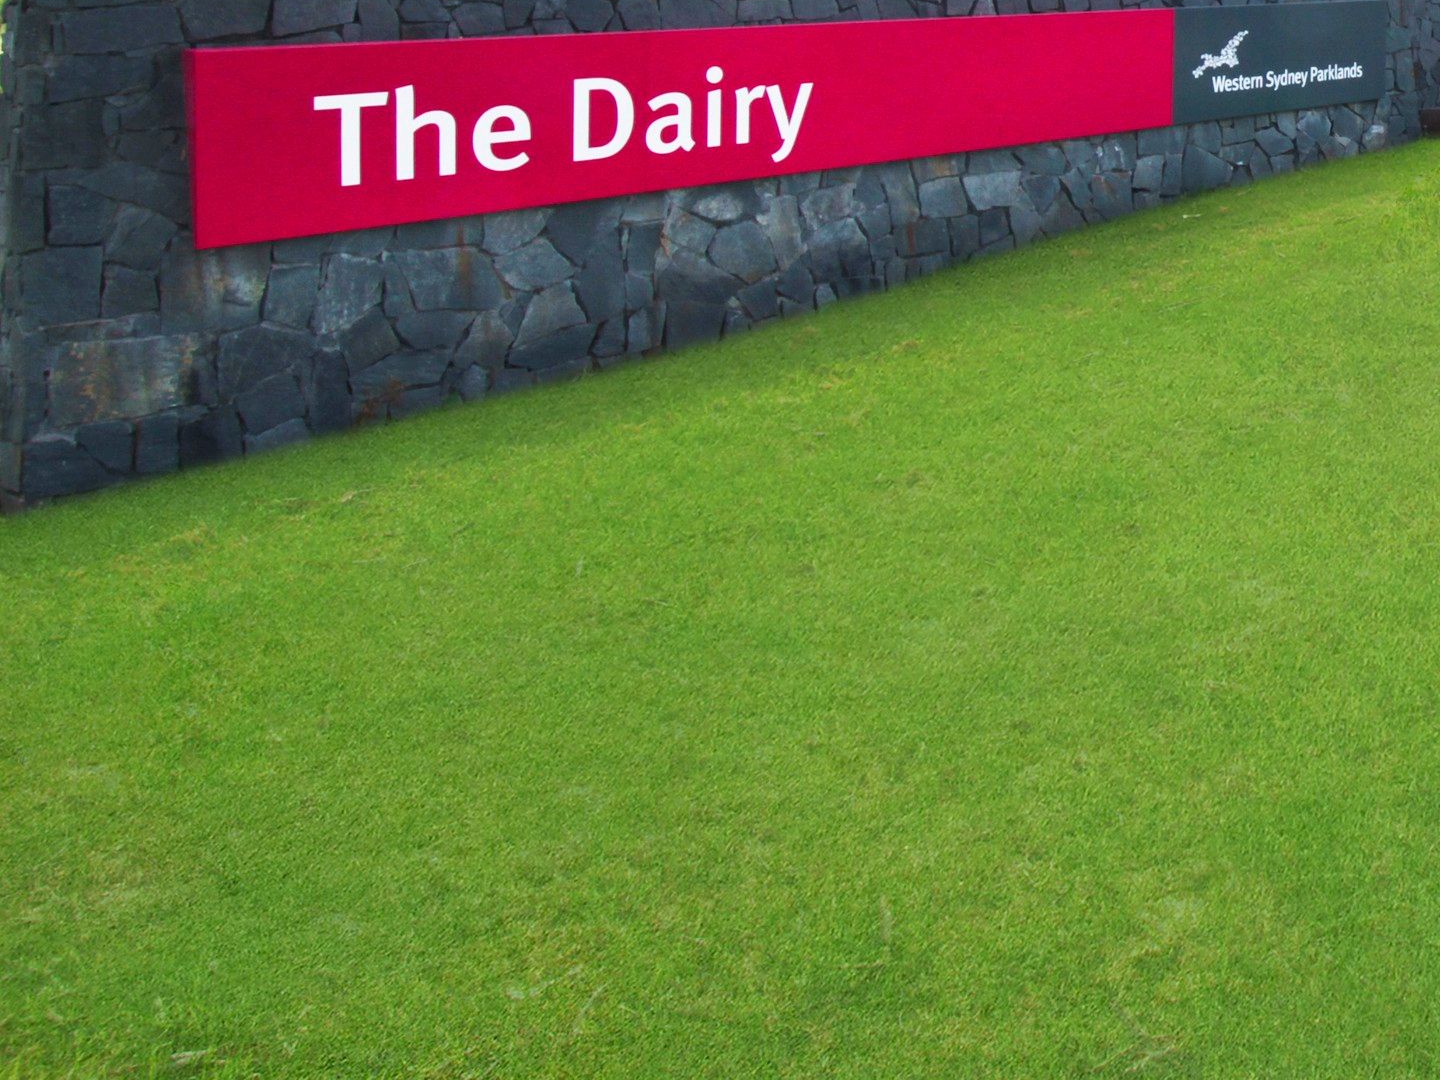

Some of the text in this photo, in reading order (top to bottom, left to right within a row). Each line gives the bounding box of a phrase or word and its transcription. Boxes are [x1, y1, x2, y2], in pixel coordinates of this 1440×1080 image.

[1212, 62, 1363, 93] Western Sydney Parklands
[313, 66, 814, 187] The Dairy
